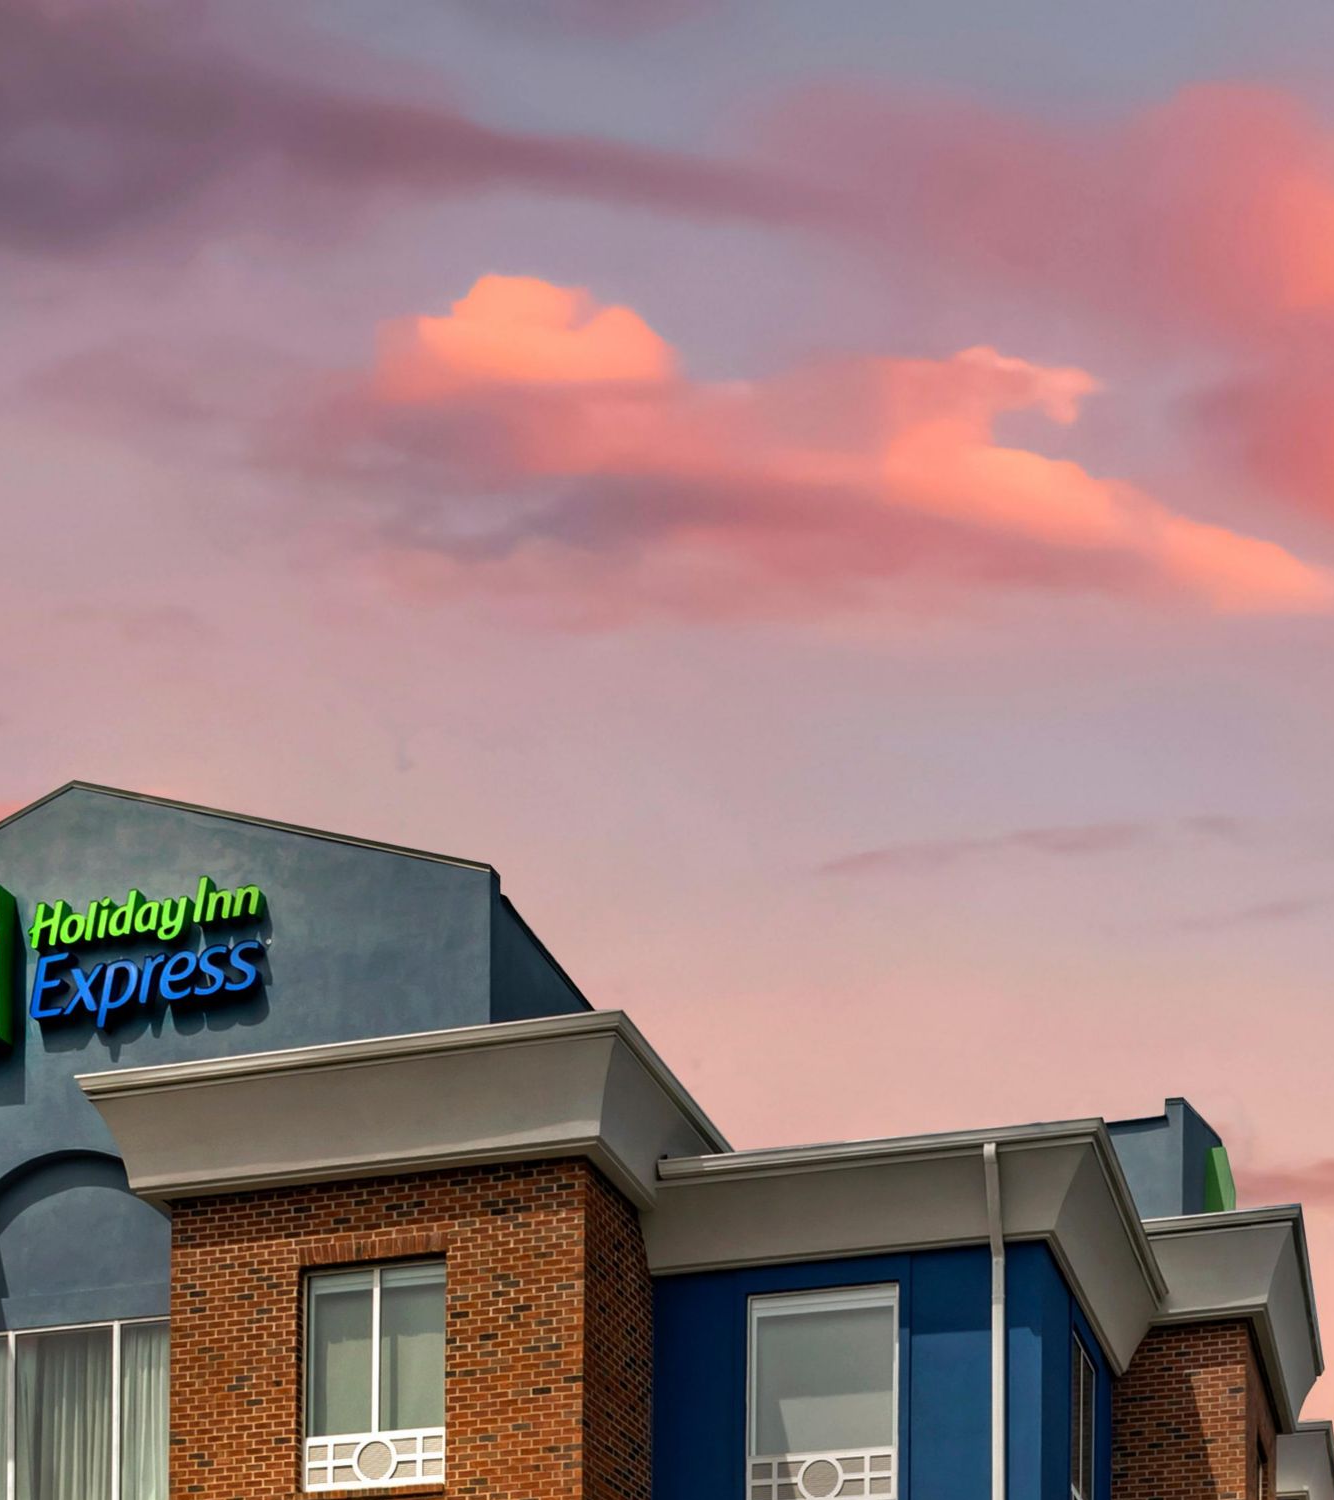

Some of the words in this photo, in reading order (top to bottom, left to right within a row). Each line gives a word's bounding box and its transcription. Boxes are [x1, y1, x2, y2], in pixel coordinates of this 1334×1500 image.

[28, 889, 187, 949] Holiday
[194, 876, 264, 922] Inn
[30, 940, 264, 1028] Express
